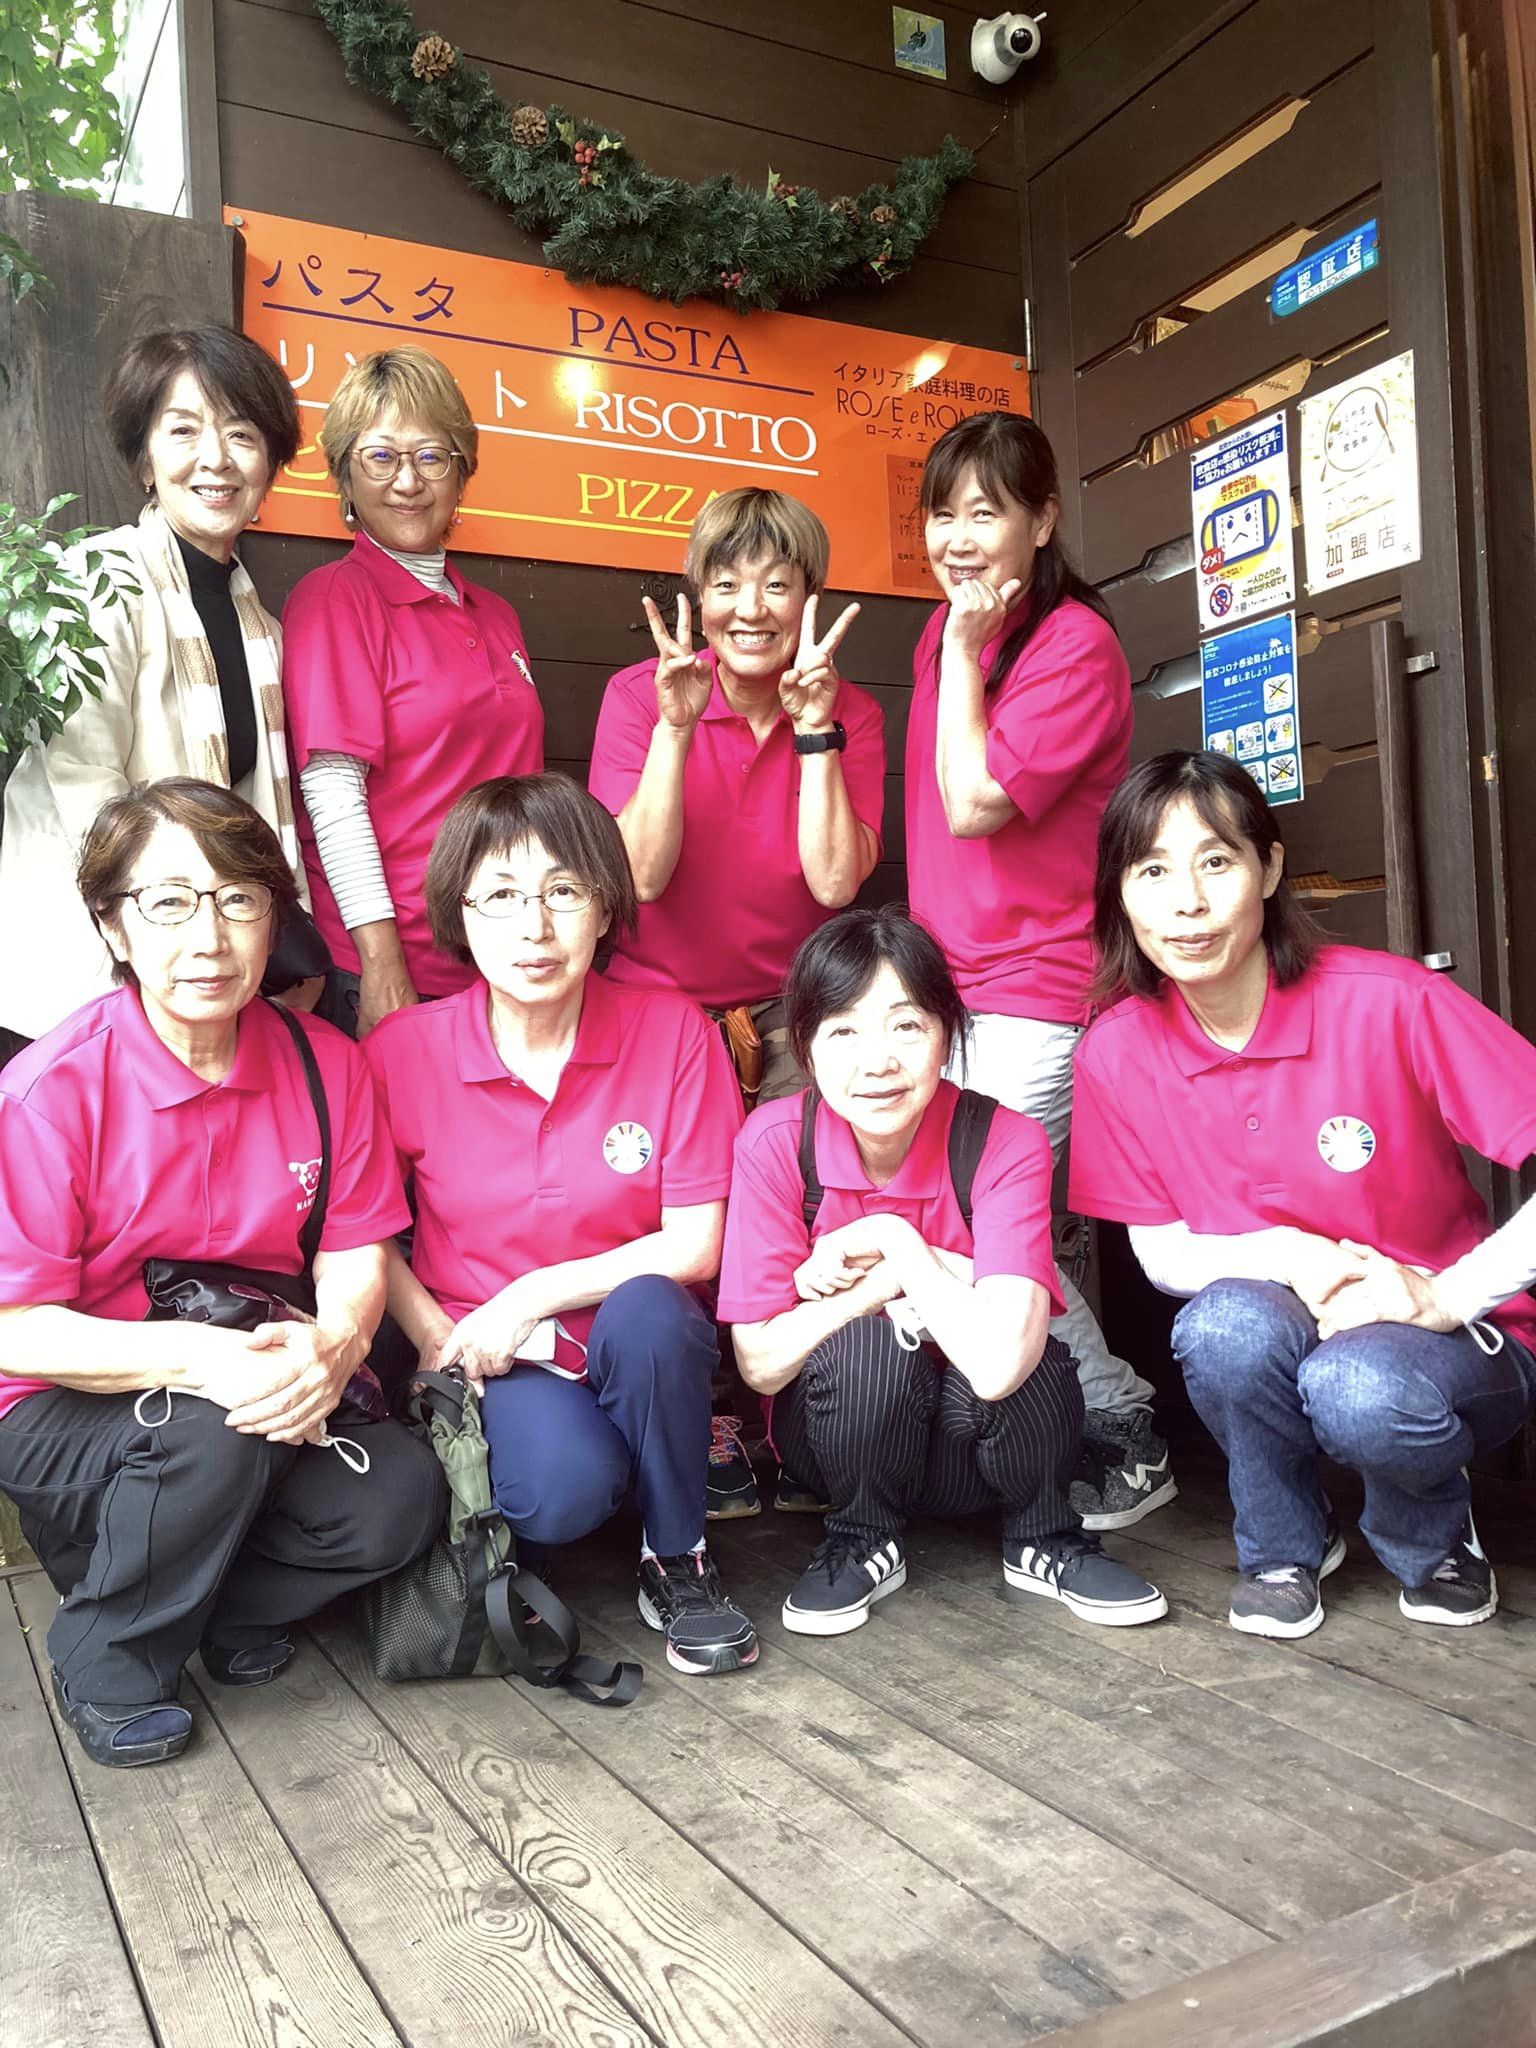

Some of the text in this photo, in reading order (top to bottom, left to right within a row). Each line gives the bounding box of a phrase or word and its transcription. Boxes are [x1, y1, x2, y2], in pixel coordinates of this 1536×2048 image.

[262, 254, 455, 322] パスタ
[567, 307, 750, 375] PASTA
[574, 389, 818, 463] RISOTTO
[577, 473, 719, 524] PIZZ
[1325, 525, 1396, 567] 加盟店
